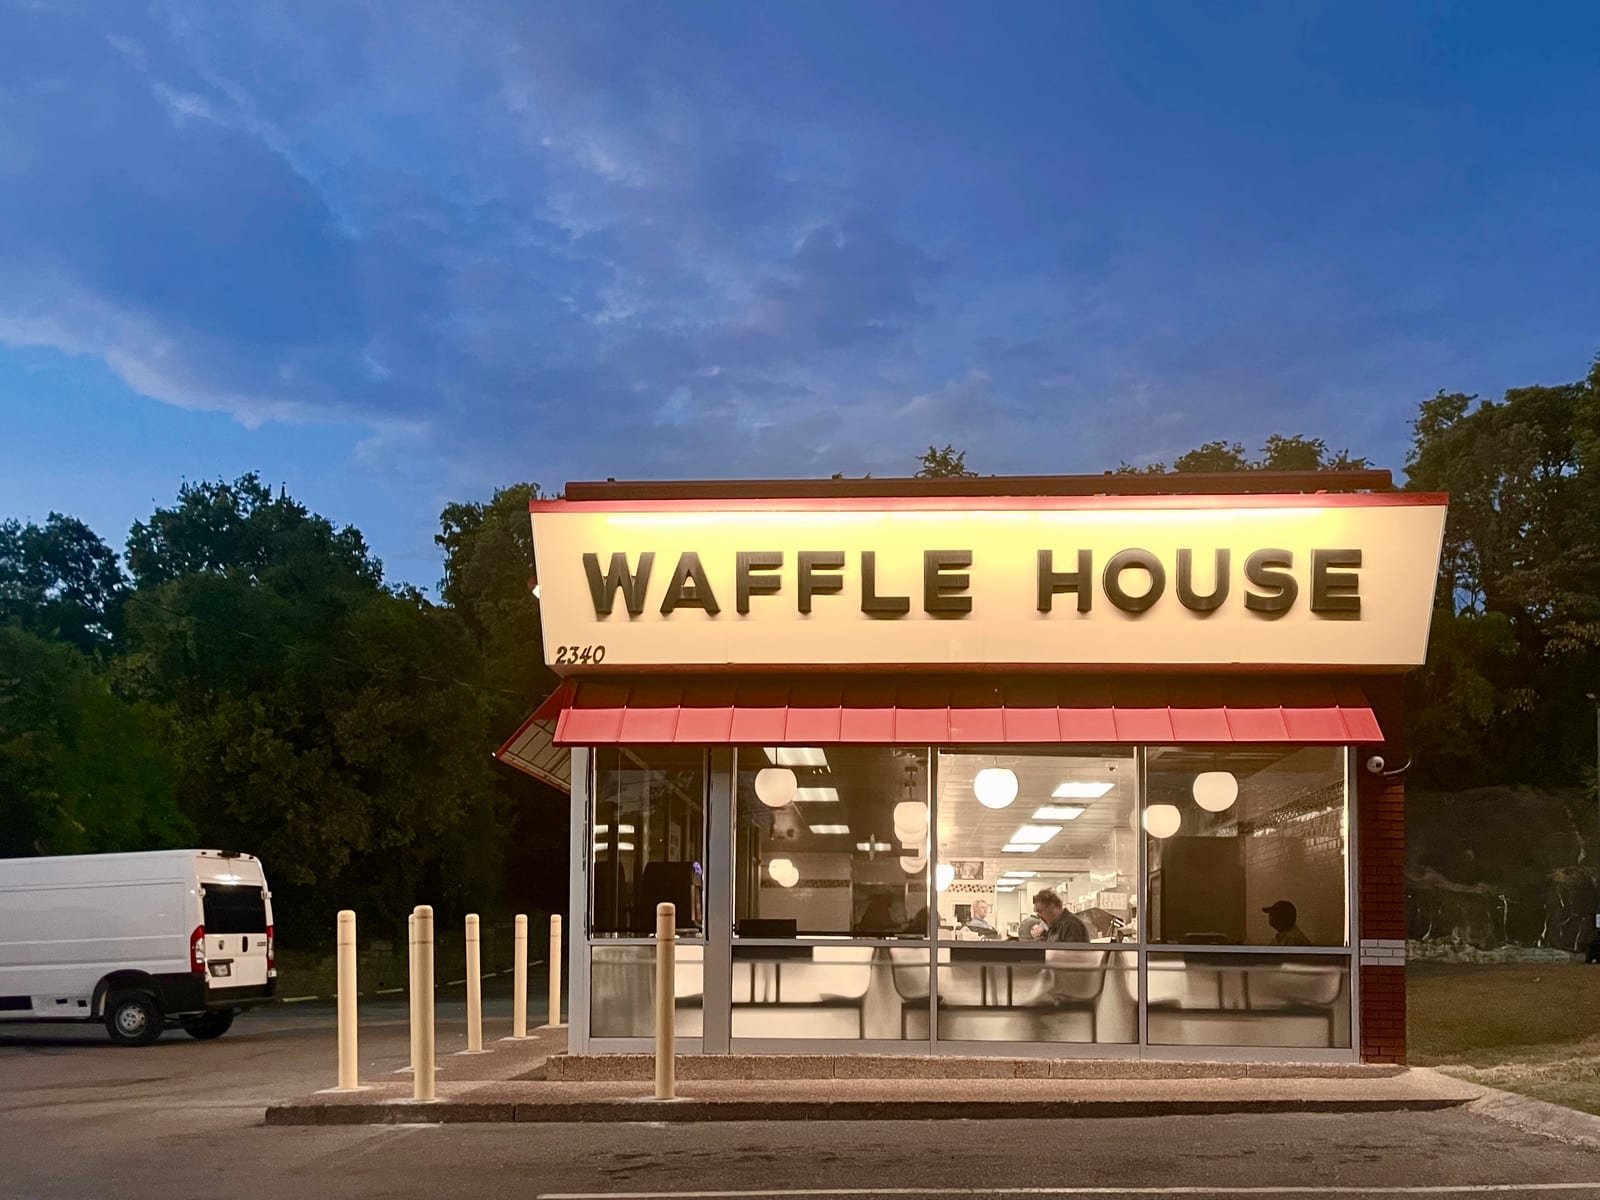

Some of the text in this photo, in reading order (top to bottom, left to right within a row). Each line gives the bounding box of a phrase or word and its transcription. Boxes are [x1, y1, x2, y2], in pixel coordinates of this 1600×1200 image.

[582, 547, 1363, 618] WAFFLE HOUSE
[554, 644, 606, 665] 2340
